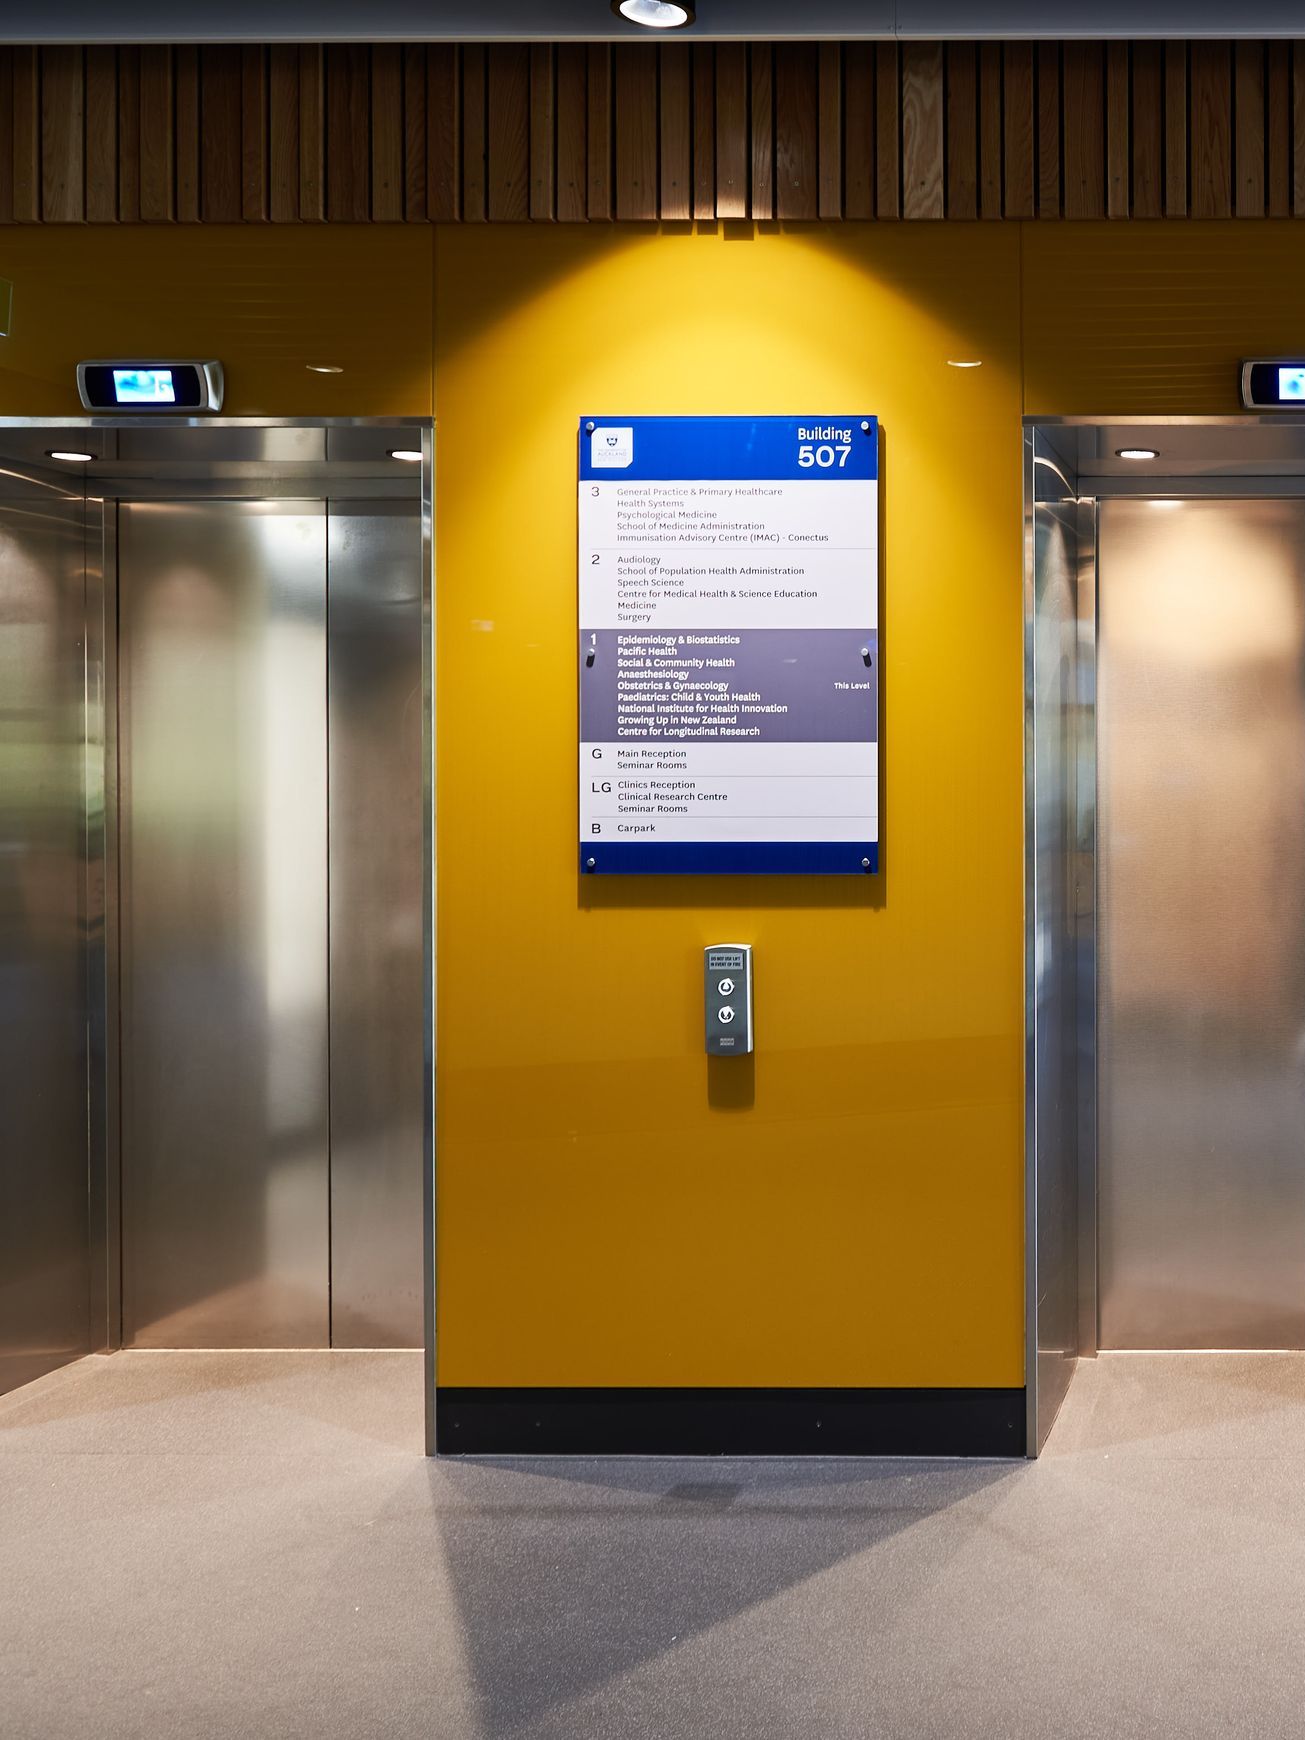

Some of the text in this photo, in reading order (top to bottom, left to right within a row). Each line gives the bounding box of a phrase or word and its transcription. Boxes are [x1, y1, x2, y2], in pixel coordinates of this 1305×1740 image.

[798, 426, 852, 443] Building
[798, 445, 851, 467] 507
[592, 486, 600, 497] 3
[617, 488, 782, 498] General Practice & Primary Healthcare
[617, 499, 684, 509] Health Systems
[617, 510, 717, 521] Psychological Medicine
[617, 521, 765, 530] School of Medicine Administration
[617, 534, 677, 542] Immunisation
[678, 534, 716, 543] Advisory
[718, 534, 748, 542] Centre
[750, 533, 780, 543] (IMAC)
[788, 534, 828, 542] Conectus
[592, 554, 600, 565] 2
[617, 555, 661, 566] Audiology
[618, 566, 804, 576] School of Population Health Administration
[618, 578, 684, 588] Speech Science
[618, 589, 818, 598] Centre for Medical Health & Science Education
[618, 601, 656, 610] Medicine
[618, 613, 652, 623] Surgery
[590, 633, 596, 645] 1
[618, 634, 740, 647] Epidemiology & Biostatistics
[618, 646, 677, 656] Pacific Health
[617, 658, 735, 669] Social & Community Health
[617, 669, 689, 680] Anaesthesiology
[618, 680, 729, 692] Obstetrics & Gynaecology
[618, 691, 760, 702] Paediatrics: Child & Youth Health
[618, 703, 788, 713] National Institute for Health Innovation
[618, 715, 736, 726] Growing Up in New Zealand
[618, 726, 760, 738] Centre for Longitudinal Research
[592, 748, 602, 759] G
[642, 749, 686, 759] Reception
[617, 761, 654, 769] Seminar
[592, 782, 611, 793] LG
[618, 780, 695, 791] Clinics Reception
[618, 792, 651, 800] Clinical
[654, 792, 695, 800] Research
[618, 804, 655, 812] Seminar
[592, 823, 601, 834] B
[618, 824, 656, 834] Carpark
